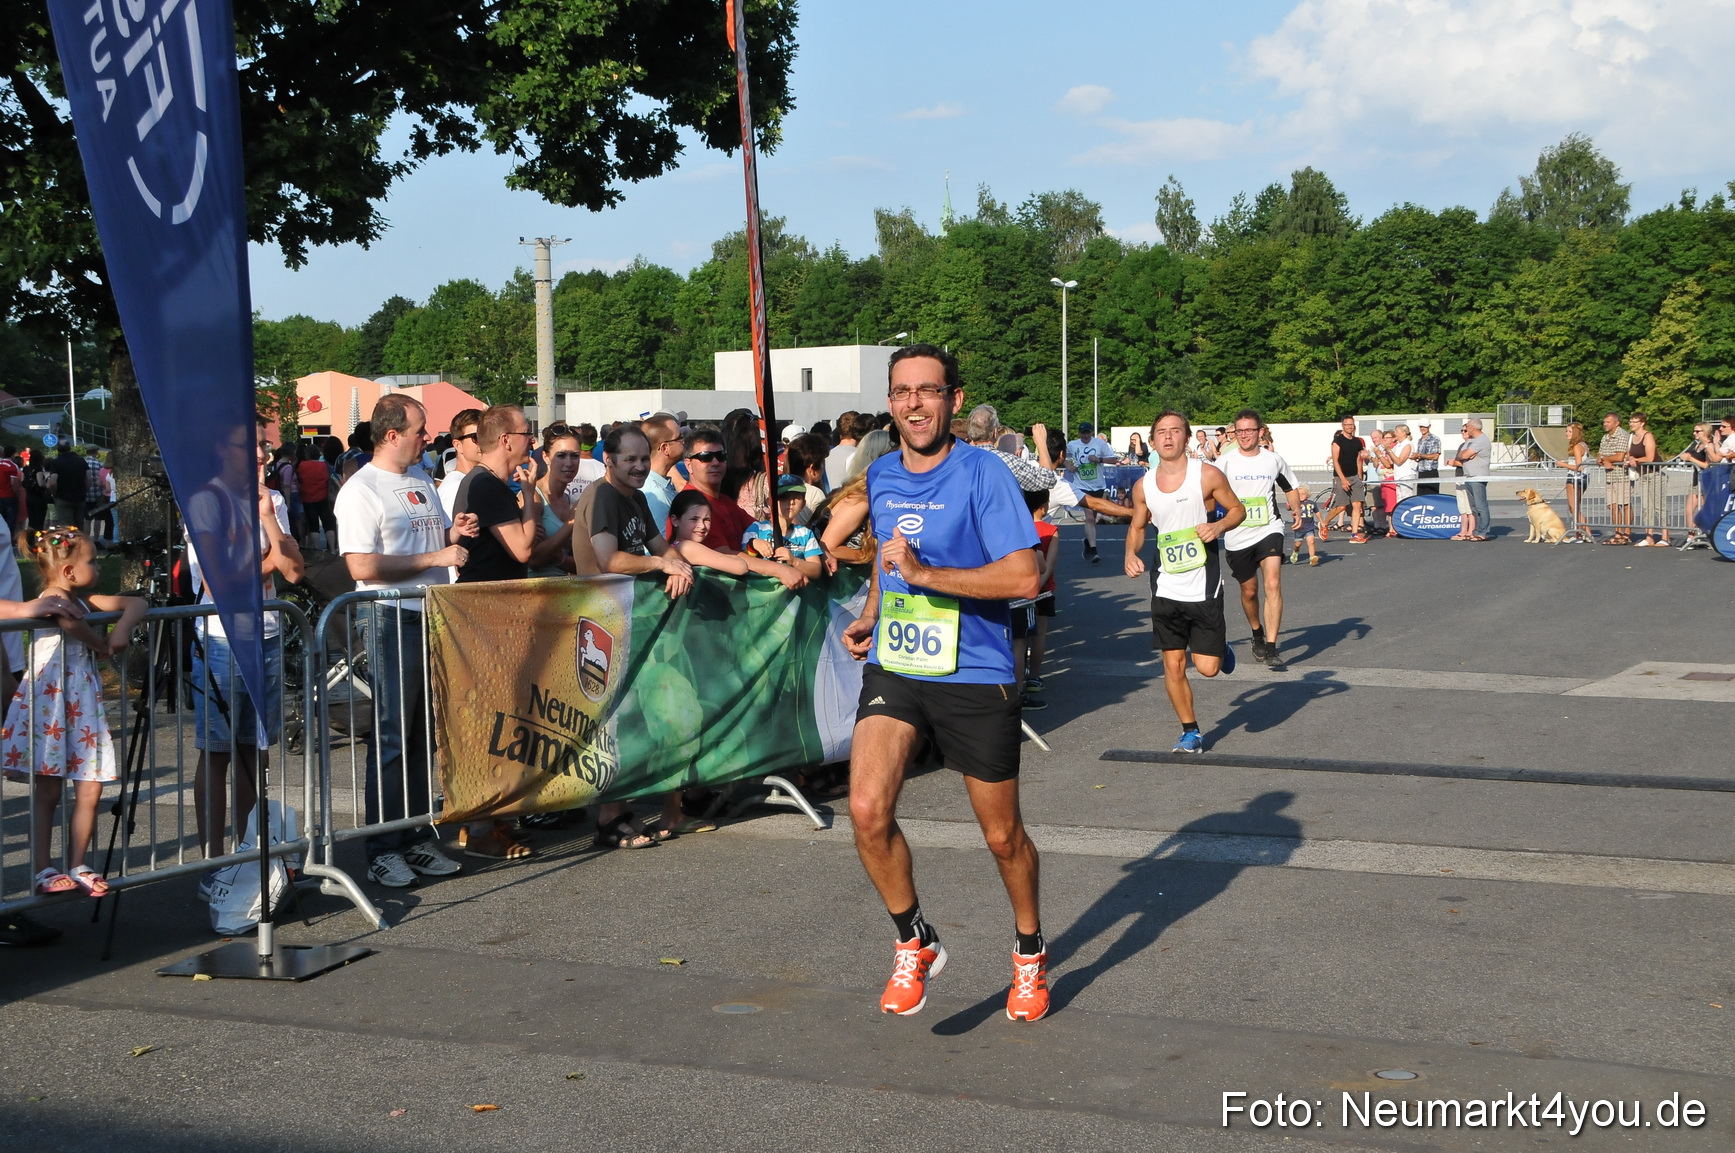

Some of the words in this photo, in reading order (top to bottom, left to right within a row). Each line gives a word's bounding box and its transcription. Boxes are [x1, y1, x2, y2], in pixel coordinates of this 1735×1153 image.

[1081, 469, 1095, 477] 300
[1247, 507, 1261, 519] 11
[1165, 542, 1198, 563] 876
[888, 620, 942, 656] 996
[584, 677, 600, 695] 1628
